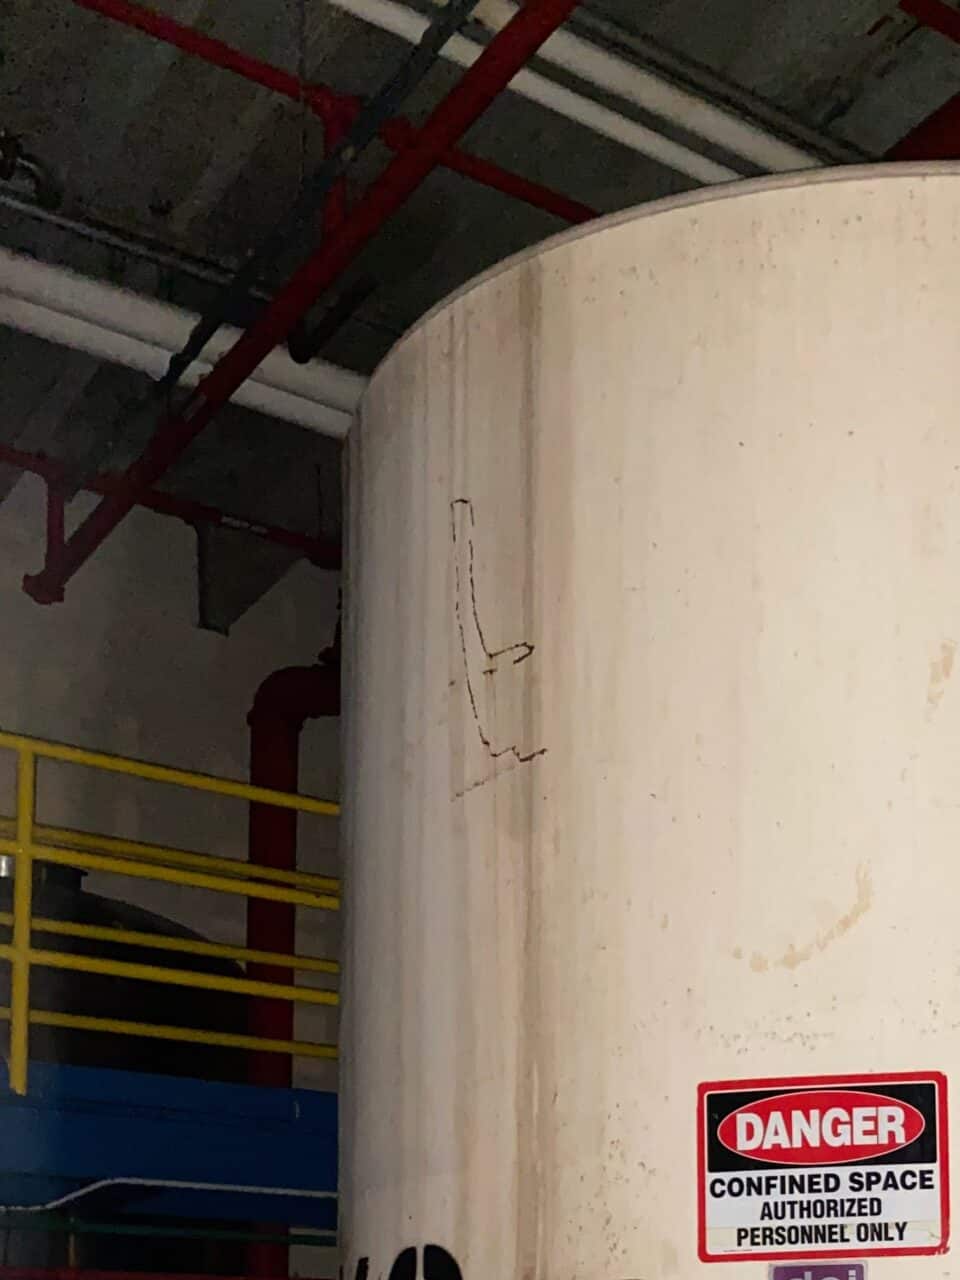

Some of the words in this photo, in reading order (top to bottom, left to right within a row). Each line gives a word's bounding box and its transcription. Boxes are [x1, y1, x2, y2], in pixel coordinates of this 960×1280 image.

[735, 1105, 906, 1151] DANGER
[709, 1173, 841, 1198] CONFINED
[848, 1169, 935, 1193] SPACE
[759, 1197, 882, 1221] AUTHORIZED
[736, 1224, 850, 1247] PERSONNEL
[856, 1221, 908, 1243] ONLY
